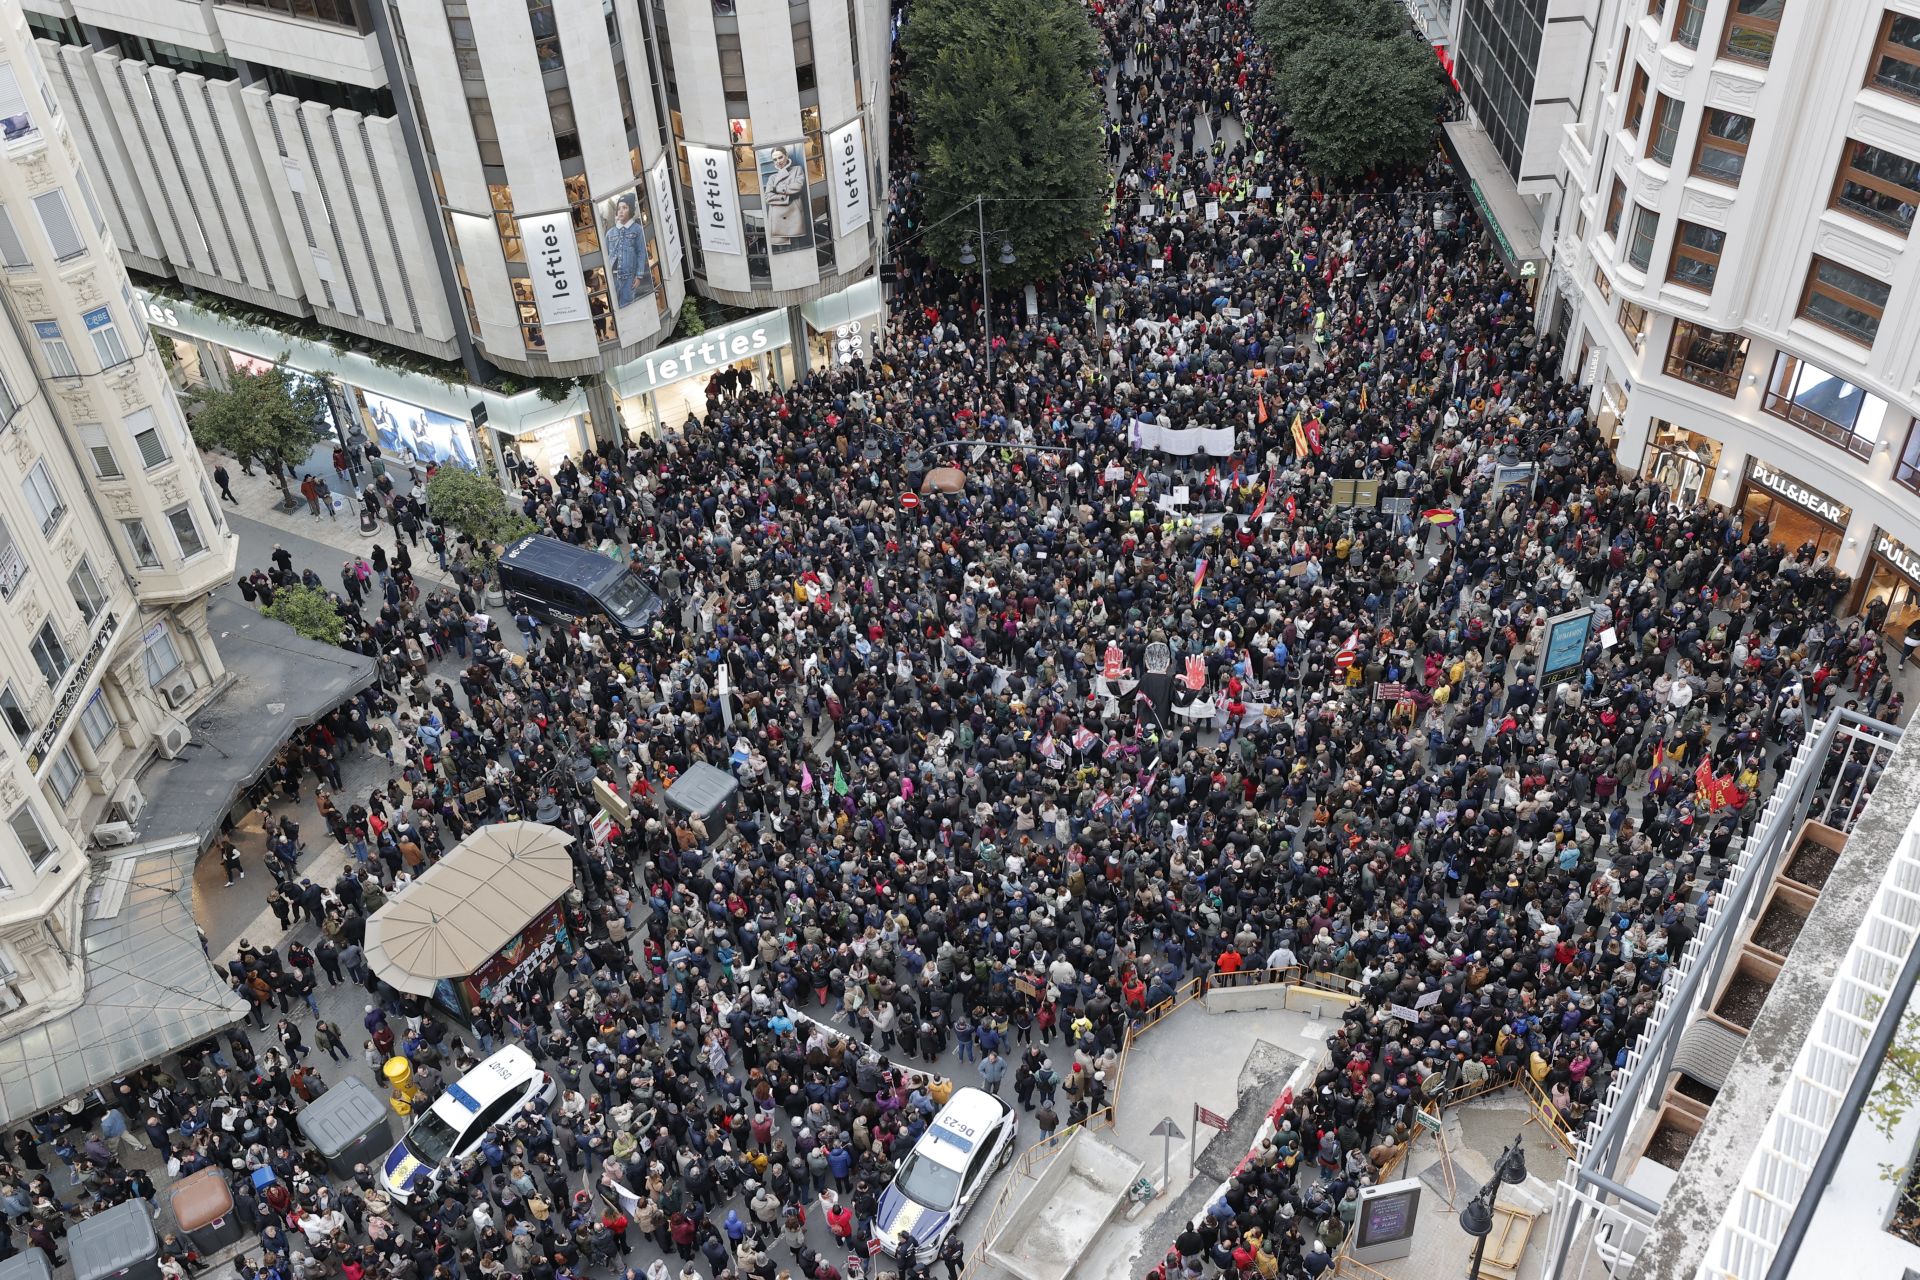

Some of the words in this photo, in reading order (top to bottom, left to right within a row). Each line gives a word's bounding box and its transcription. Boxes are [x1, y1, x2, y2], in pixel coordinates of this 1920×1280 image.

[703, 157, 726, 229] lefties
[843, 132, 859, 208] lefties
[659, 167, 675, 245] lefties
[541, 223, 570, 299] lefties
[135, 292, 179, 327] ies
[645, 327, 769, 386] lefties
[1752, 465, 1841, 523] PULL&BEAR
[37, 703, 65, 753] BRICKS
[65, 671, 83, 705] AND
[488, 1061, 512, 1081] DSV-07
[943, 1115, 976, 1138] D6-23
